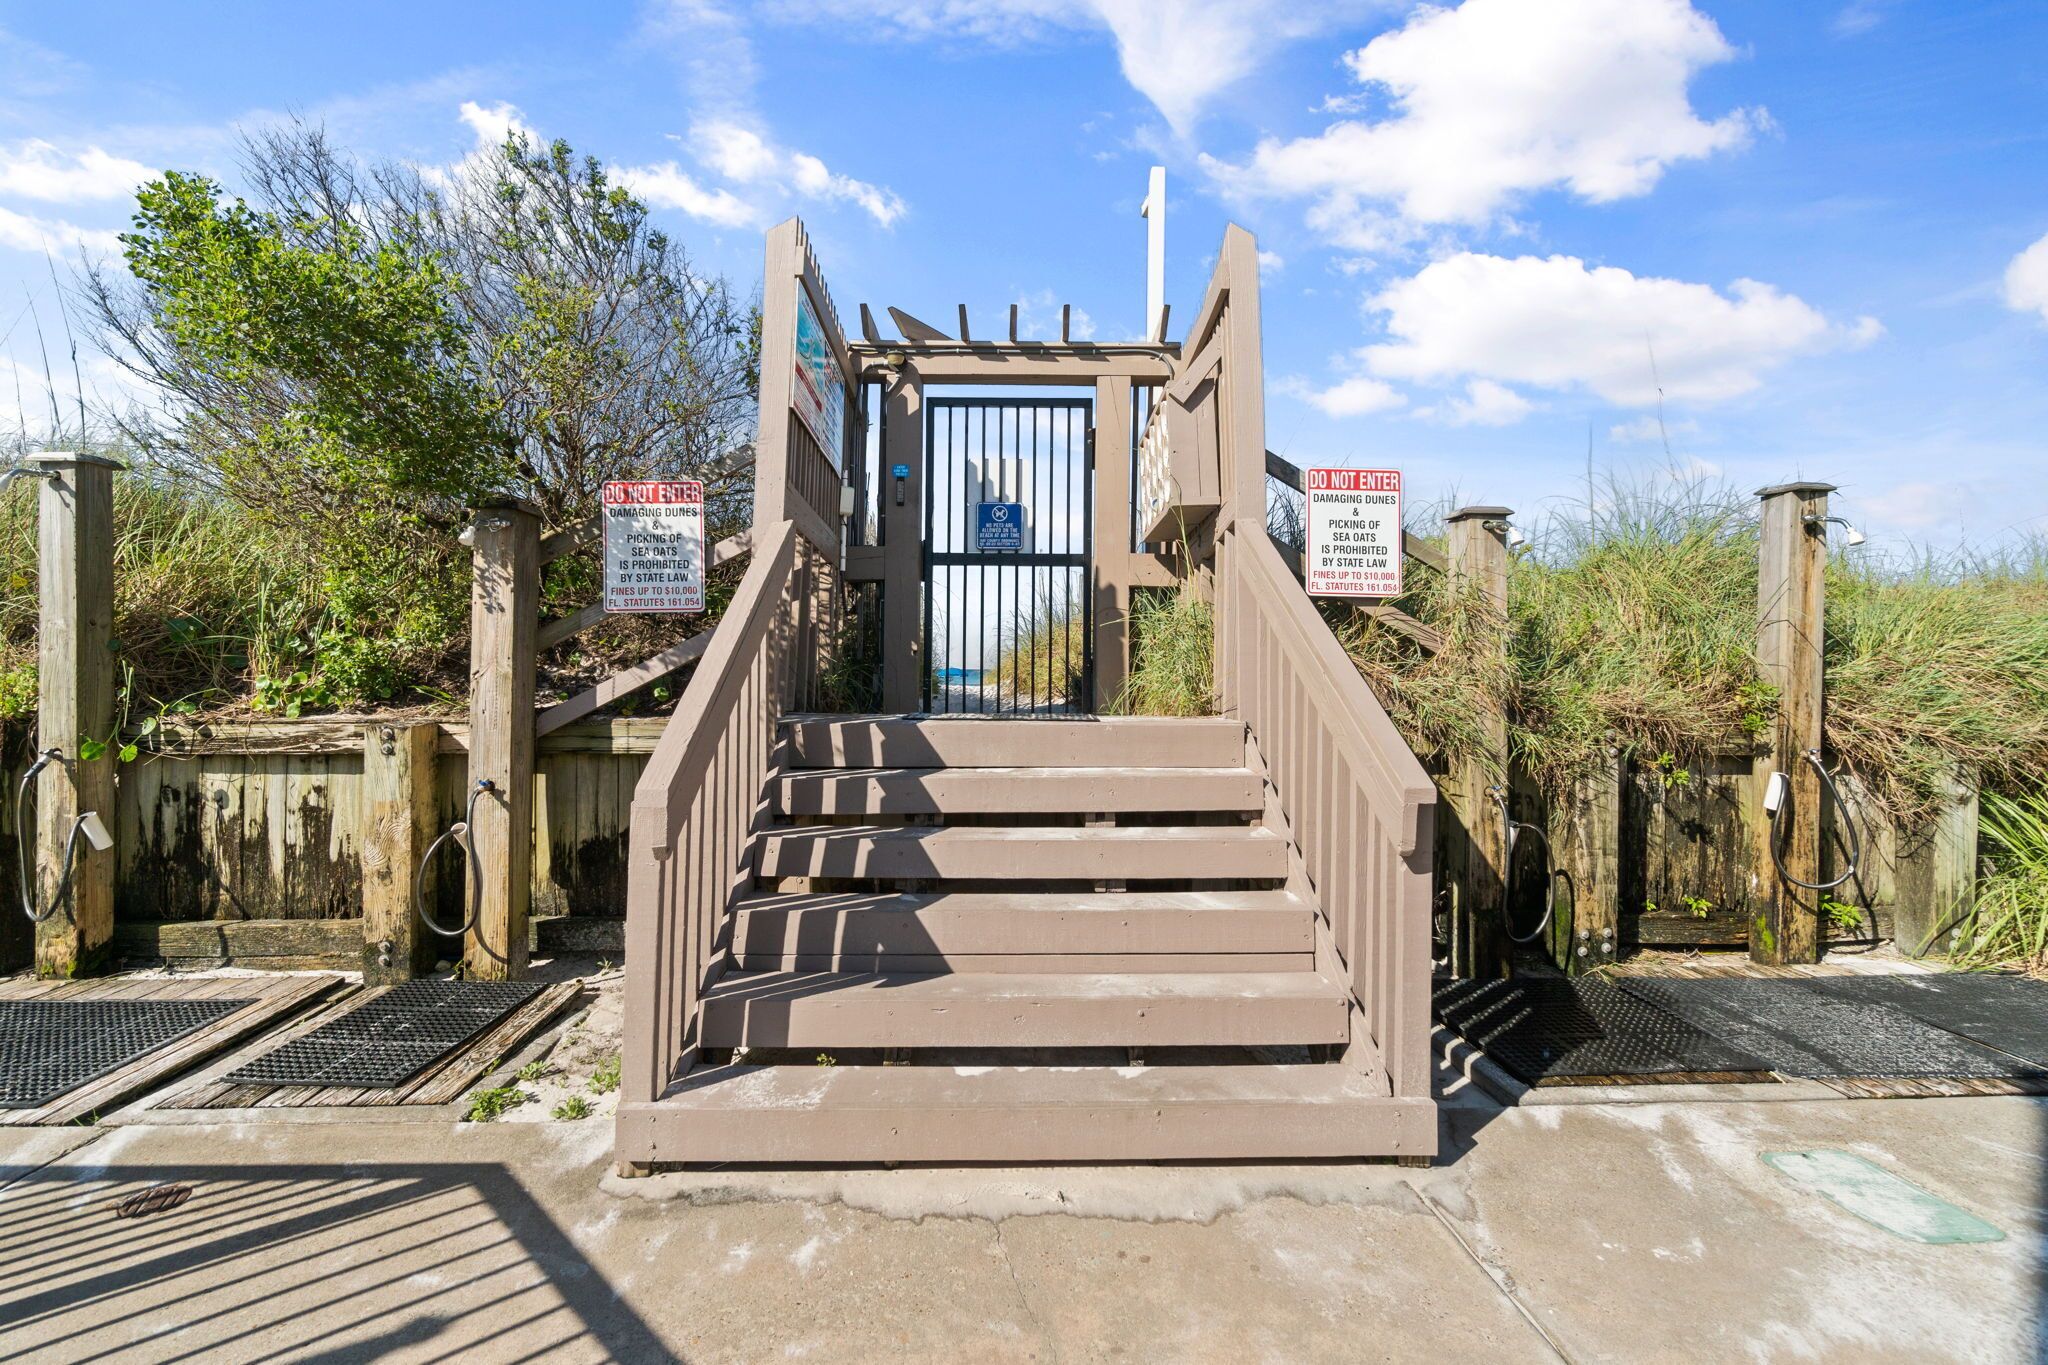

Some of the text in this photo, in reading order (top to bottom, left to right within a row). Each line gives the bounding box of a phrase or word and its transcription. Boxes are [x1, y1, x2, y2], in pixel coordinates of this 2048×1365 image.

[1310, 471, 1399, 490] DO NOT ENTER
[606, 484, 699, 502] DO NOT ENTER
[1313, 494, 1395, 505] DAMAGING DUNES
[610, 508, 698, 517] DAMAGING DUNES
[1353, 508, 1359, 516] &
[652, 521, 659, 530] &
[1329, 520, 1380, 529] PICKING OF
[627, 534, 681, 543] PICKING OF
[1333, 533, 1376, 542] SEA OATS
[632, 547, 677, 556] SEA OATS
[1322, 545, 1387, 555] IS PROHIBITED
[620, 560, 689, 569] IS PROHIBITED
[1323, 558, 1386, 568] BY STATE LAW
[621, 573, 688, 582] BY STATE LAW
[1313, 571, 1335, 579] FINES
[1351, 572, 1361, 580] TO
[1364, 572, 1395, 581] $10,000
[611, 586, 697, 596] FINES UP TO $10,000
[1312, 582, 1397, 591] FL. STATUTES 161.054
[609, 598, 699, 607] FL. STATUTES 161.054
